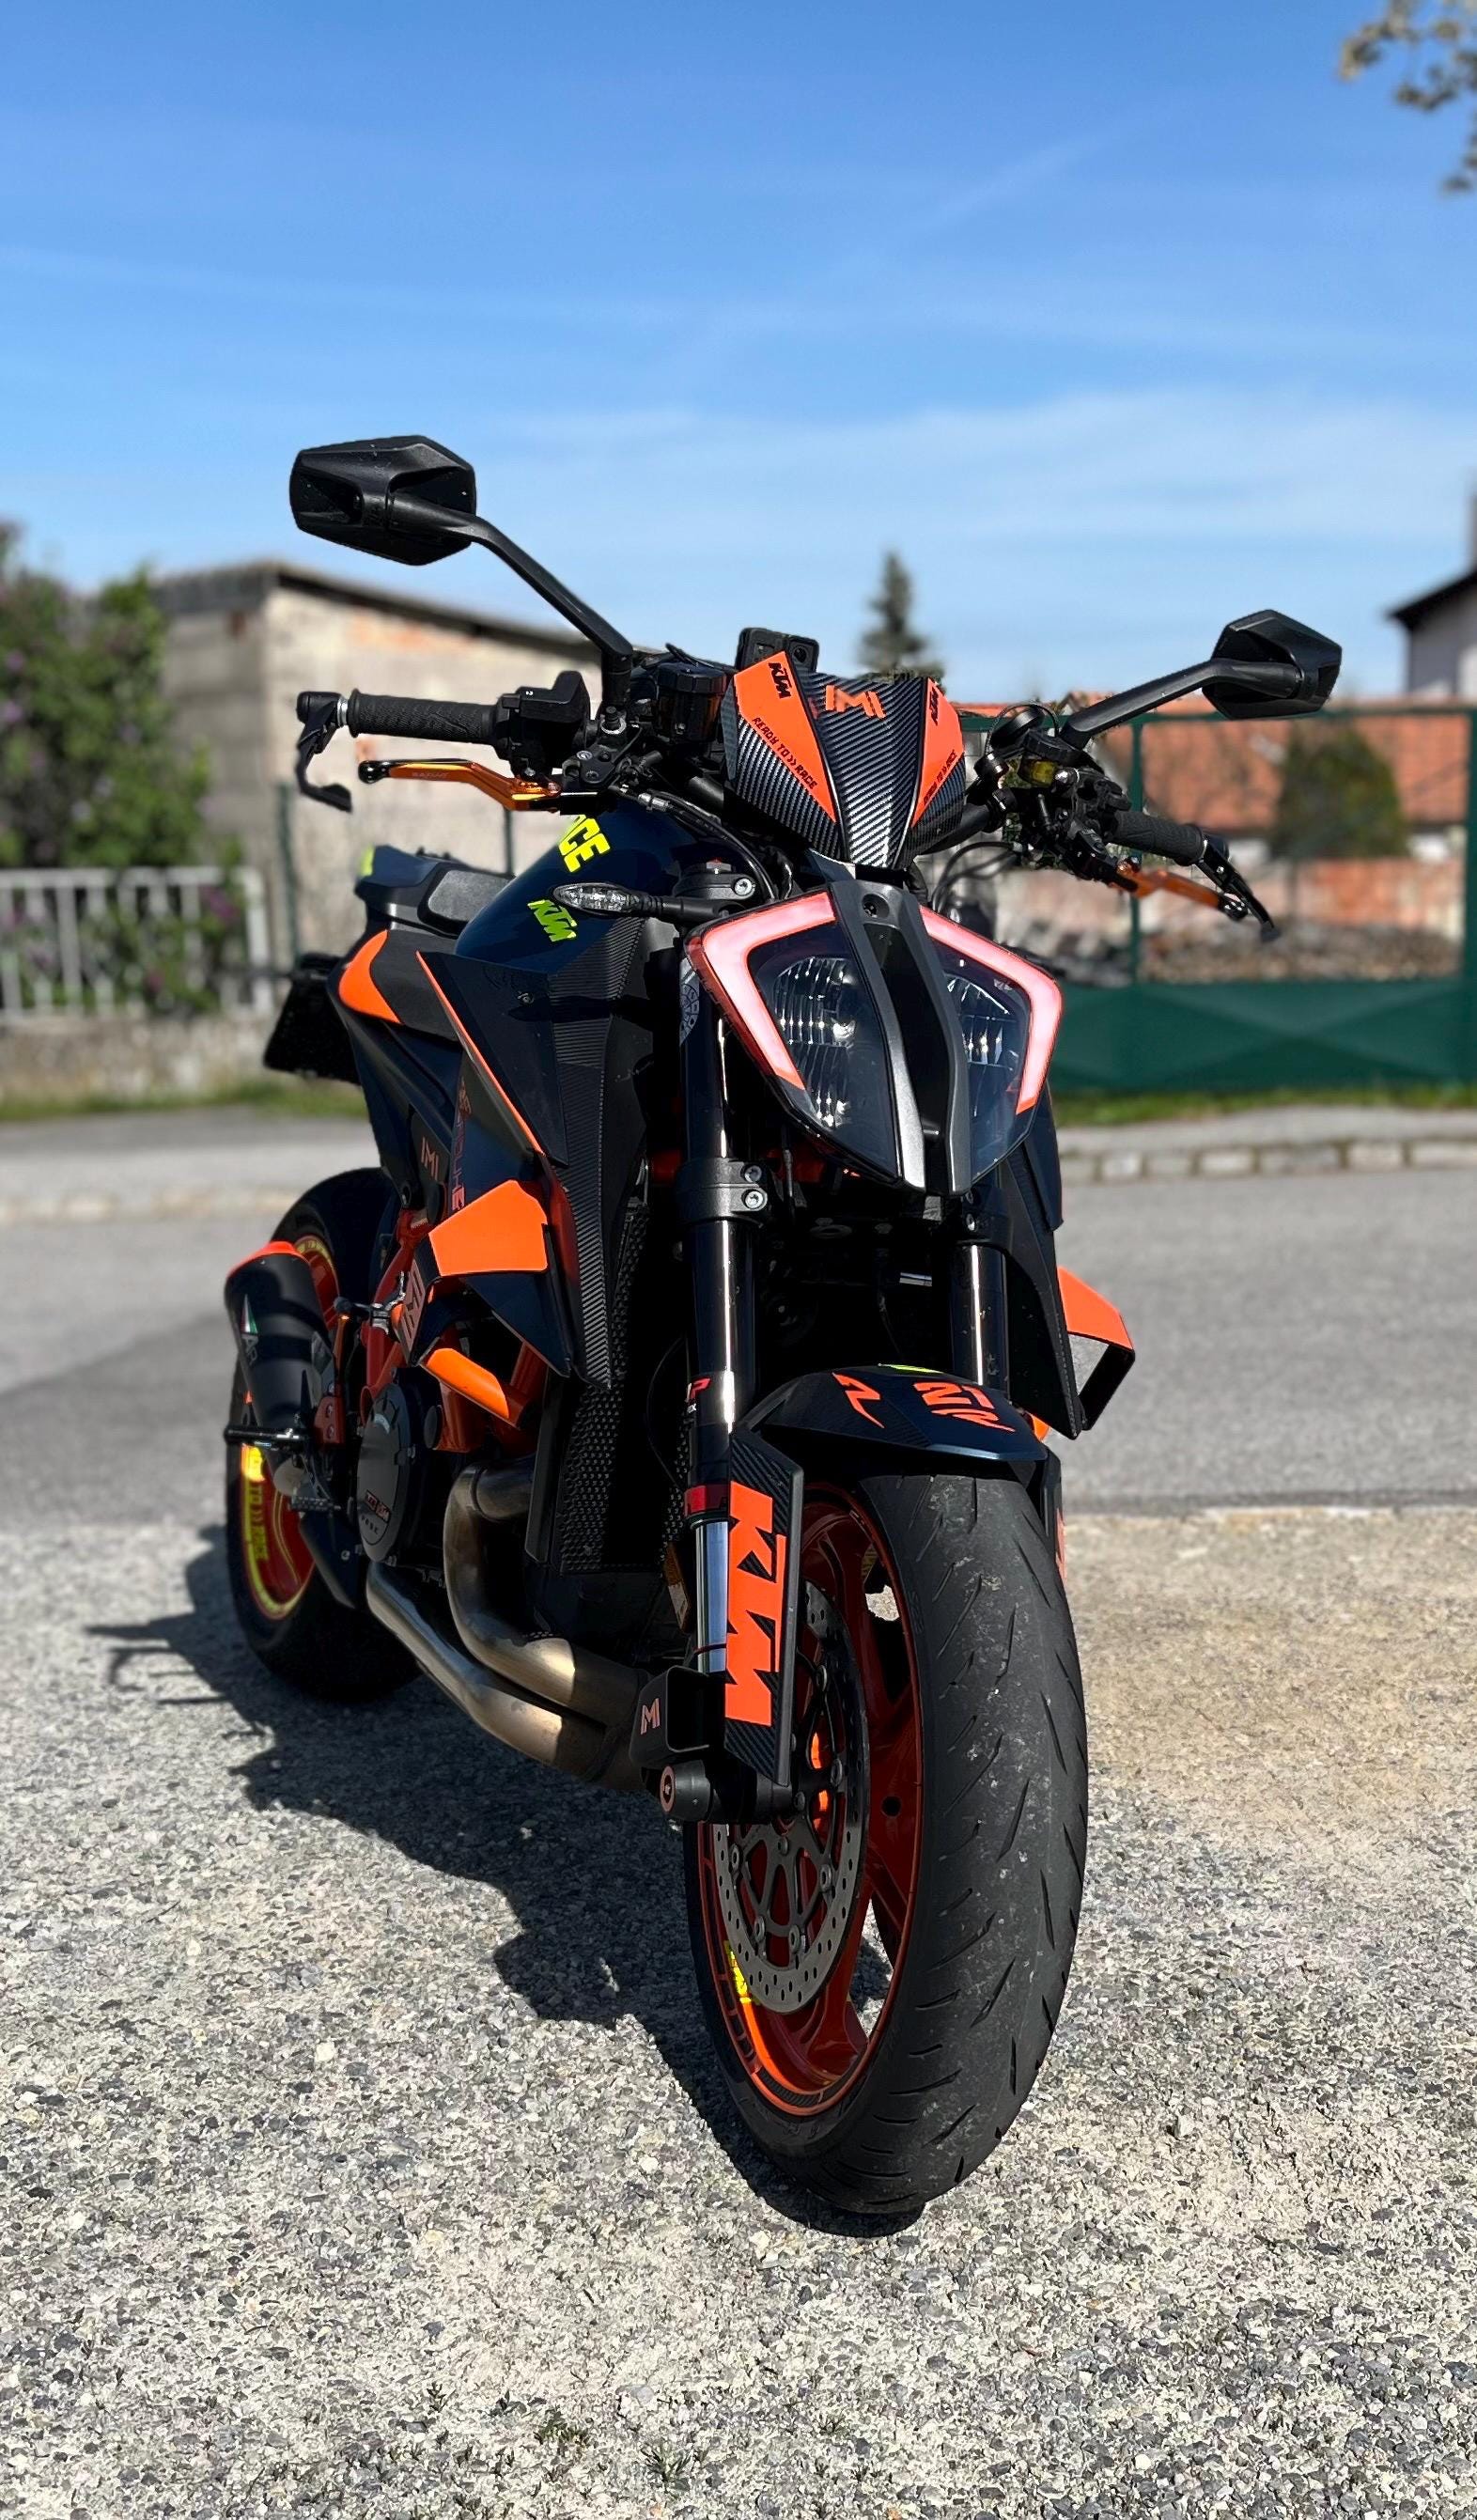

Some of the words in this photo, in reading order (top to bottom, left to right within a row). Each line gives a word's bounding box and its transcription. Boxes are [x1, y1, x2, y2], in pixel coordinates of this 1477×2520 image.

[769, 662, 792, 699] KTM
[753, 717, 780, 745] READY
[794, 764, 818, 790] RACE
[527, 898, 578, 942] KTM
[724, 1481, 786, 1727] KTM
